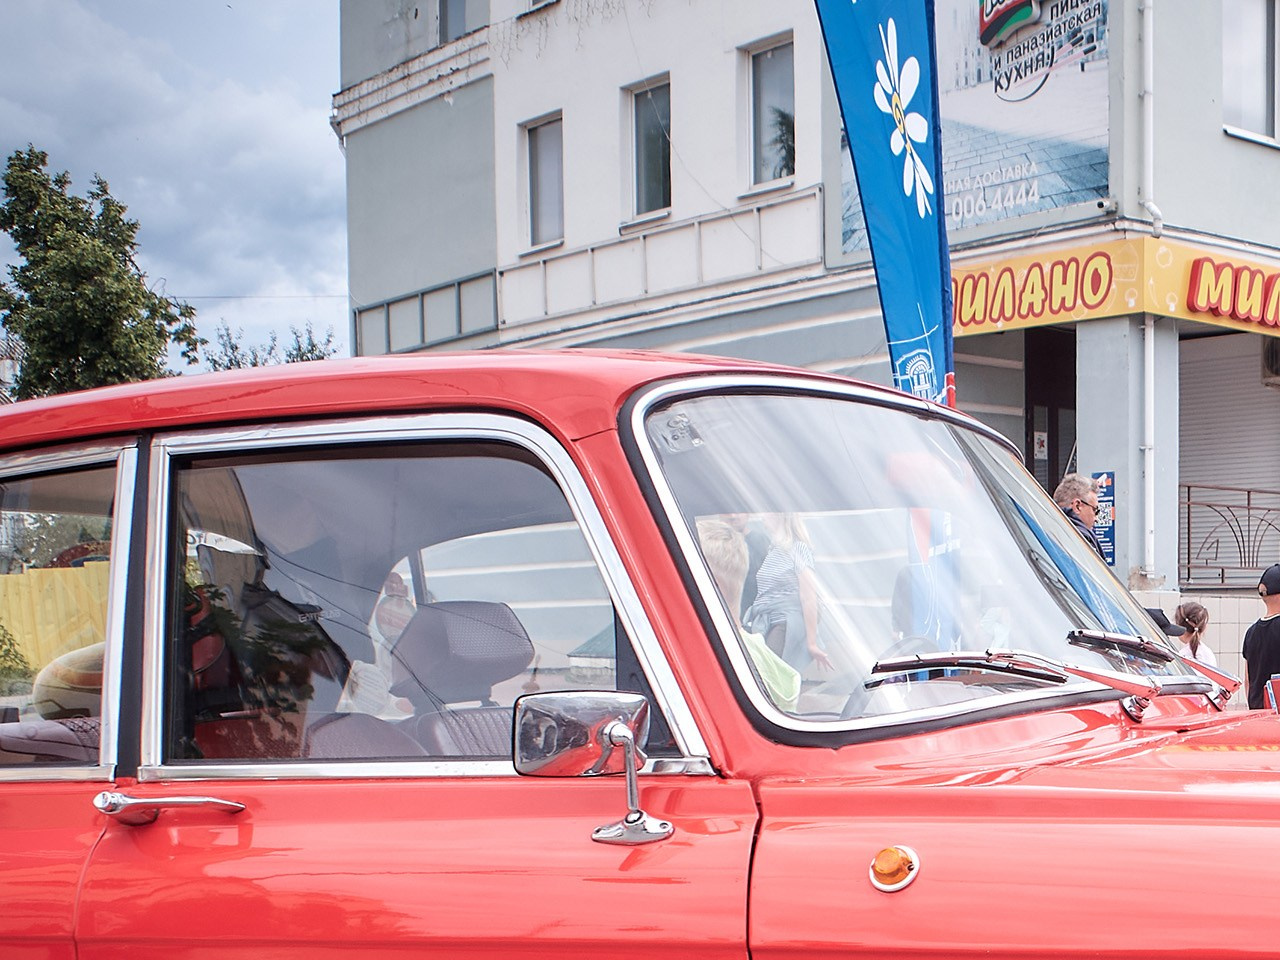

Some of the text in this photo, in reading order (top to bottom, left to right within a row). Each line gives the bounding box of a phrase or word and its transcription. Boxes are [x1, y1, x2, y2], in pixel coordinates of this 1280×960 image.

[994, 56, 1002, 71] и
[1006, 2, 1101, 64] паназиатская
[952, 180, 1040, 221] 006 4444
[973, 162, 1039, 191] ДОСТАВКА
[952, 251, 1113, 328] ИЛАНО
